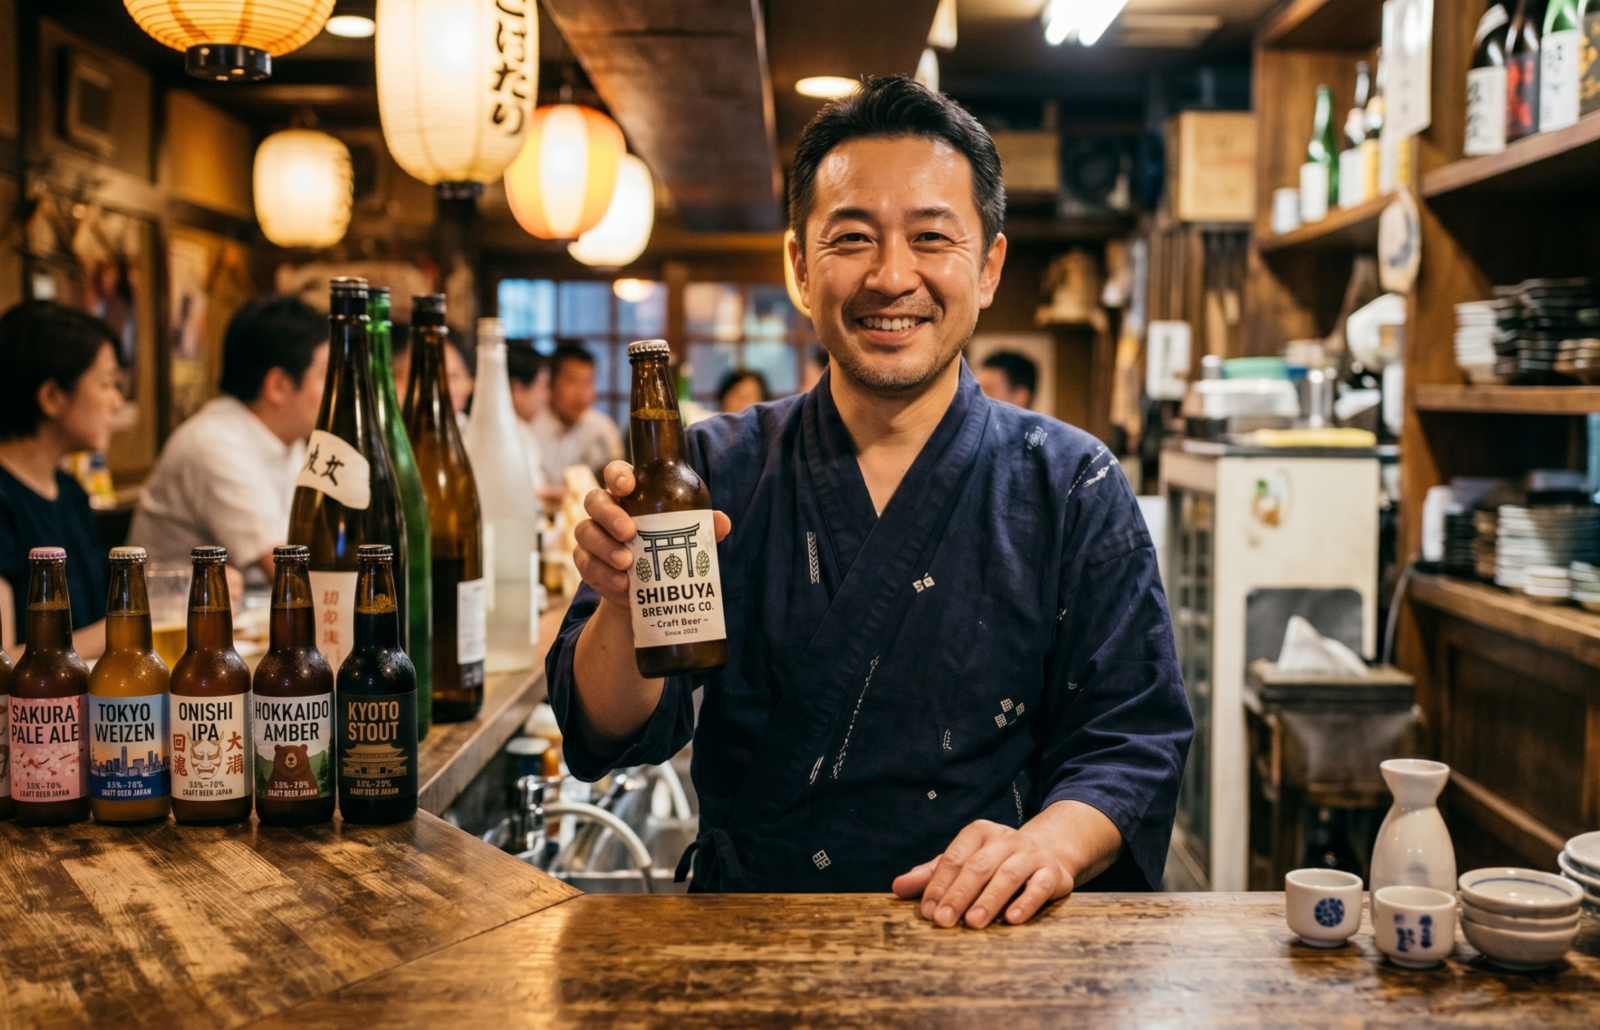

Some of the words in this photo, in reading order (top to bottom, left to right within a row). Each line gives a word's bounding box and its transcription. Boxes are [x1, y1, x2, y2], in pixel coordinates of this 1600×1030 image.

[636, 582, 715, 605] SHIBUYA
[642, 603, 695, 618] BREWING
[698, 601, 714, 611] CO.
[657, 618, 679, 628] Craft
[681, 618, 701, 626] Beer
[12, 704, 76, 725] SAKURA
[98, 703, 150, 723] TOKYO
[179, 701, 233, 722] ONISHI
[255, 700, 329, 722] HOKKAIDO
[348, 701, 399, 721] KYOTO
[12, 724, 44, 744] PALE
[49, 723, 79, 744] ALE
[95, 722, 155, 743] WEIZEN
[192, 723, 220, 742] IPA
[263, 722, 320, 742] AMBER
[348, 721, 399, 741] STOUT
[199, 789, 213, 797] BEER
[215, 788, 233, 797] JAPAN
